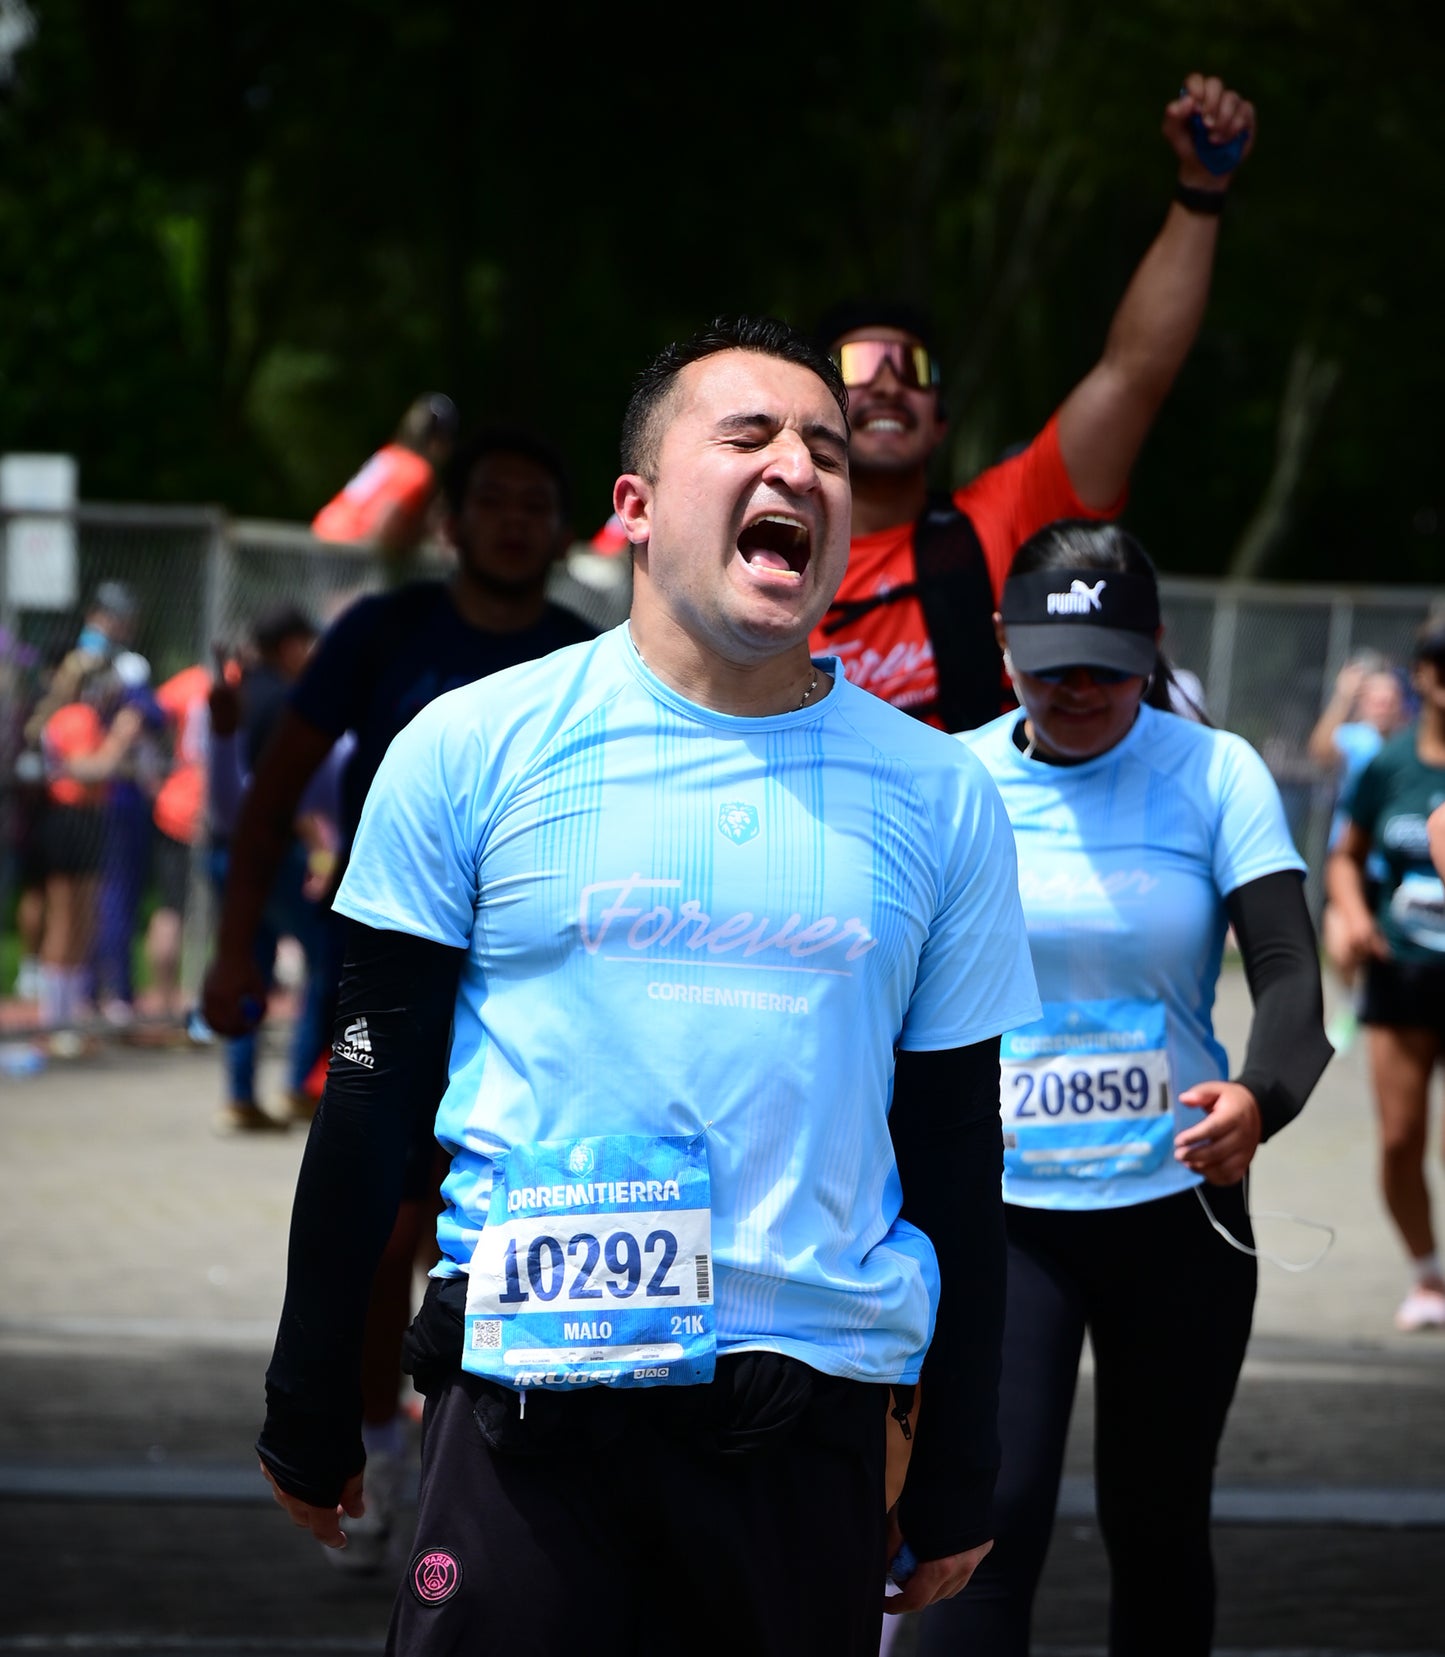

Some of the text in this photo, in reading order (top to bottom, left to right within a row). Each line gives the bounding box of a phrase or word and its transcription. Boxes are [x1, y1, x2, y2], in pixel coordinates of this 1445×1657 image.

[579, 872, 878, 961] Forever
[647, 981, 809, 1014] CORREMITIERRA
[1012, 1066, 1150, 1118] 20859
[499, 1229, 681, 1304] 10292
[563, 1321, 613, 1341] MALO
[670, 1314, 705, 1336] 21K
[424, 1555, 452, 1568] PARIS
